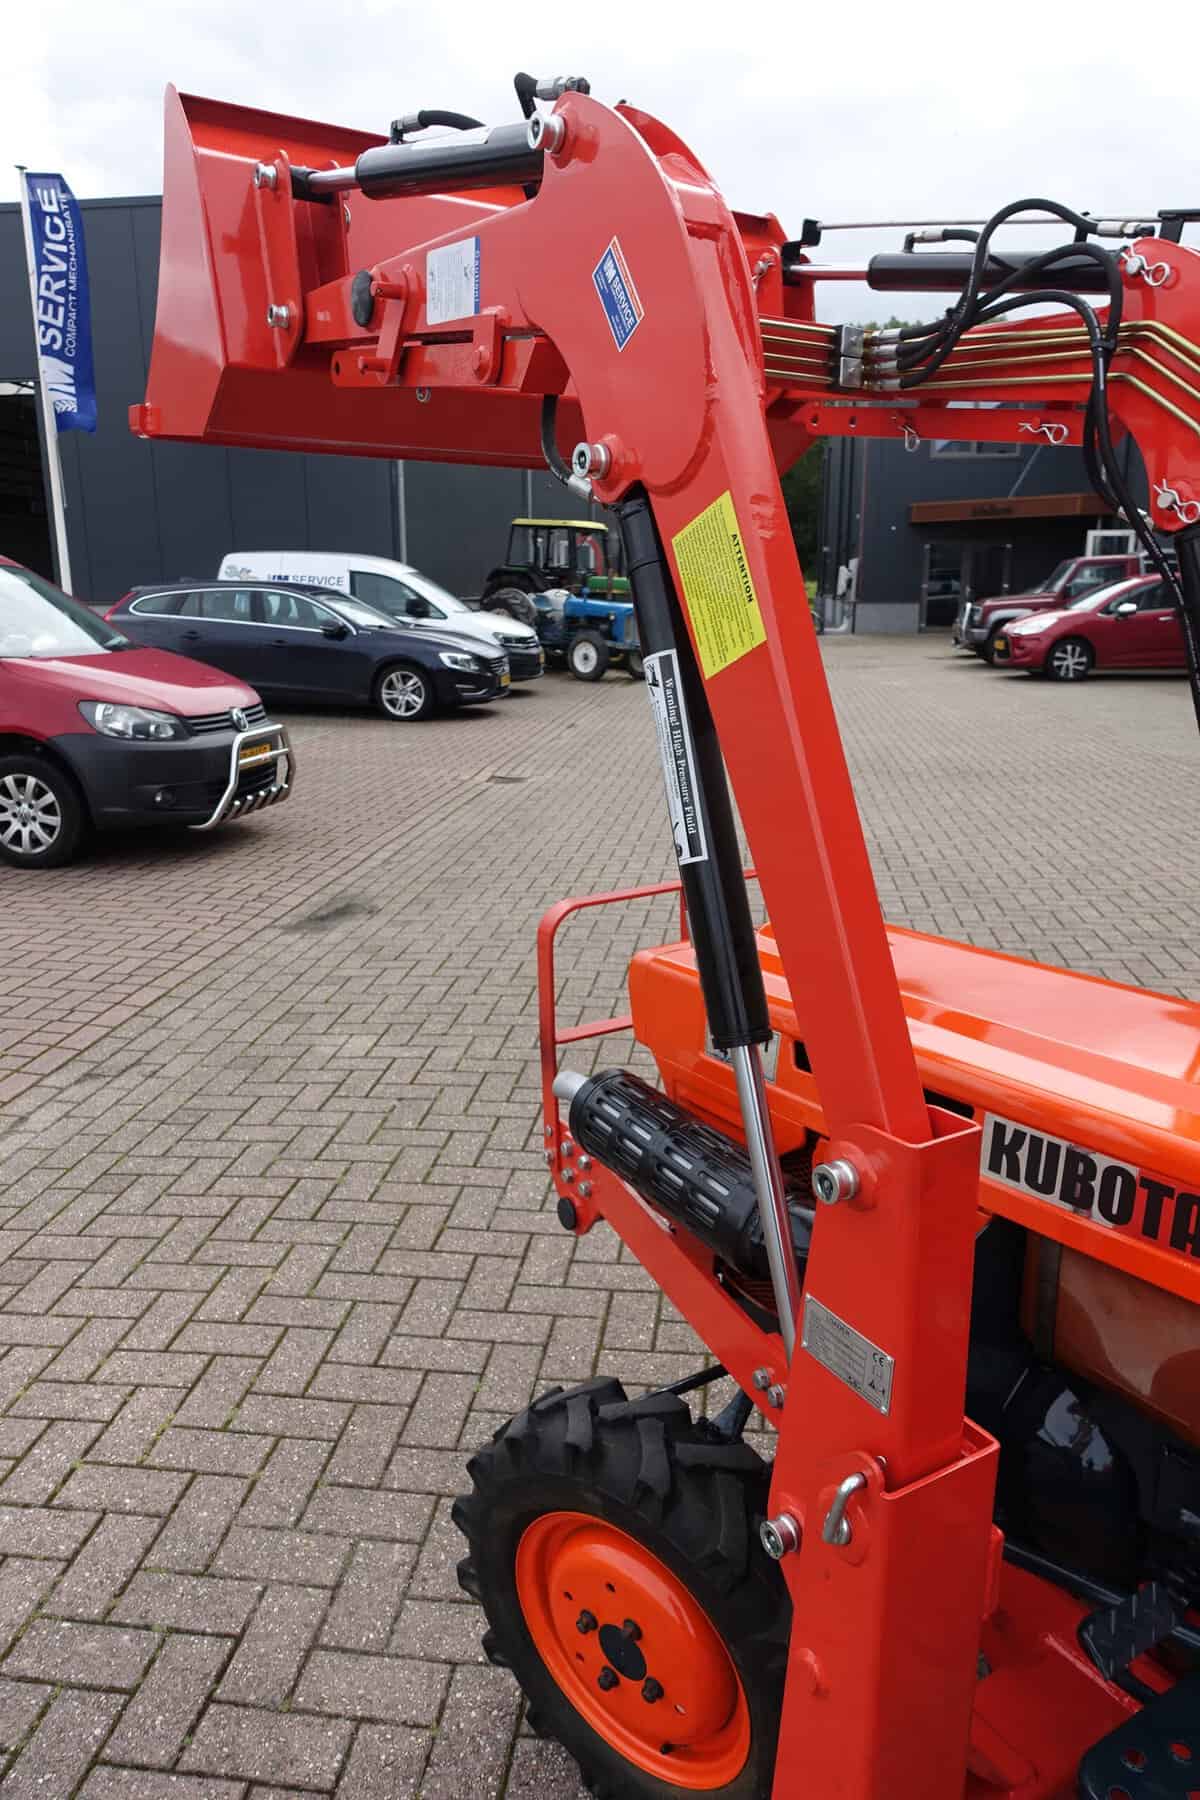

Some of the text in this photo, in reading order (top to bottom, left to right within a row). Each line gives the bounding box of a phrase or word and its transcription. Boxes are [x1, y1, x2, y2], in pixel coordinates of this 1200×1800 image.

[37, 187, 68, 351] SERVICE
[63, 293, 78, 357] COMPACT
[612, 275, 636, 331] SERVICE
[291, 575, 345, 586] SERVICE
[732, 534, 753, 603] ATTENTION
[665, 678, 680, 727] Warning!
[672, 730, 684, 756] High
[677, 759, 690, 803] Pressure
[685, 806, 697, 835] Fluid
[988, 1120, 1200, 1259] KUBOTA
